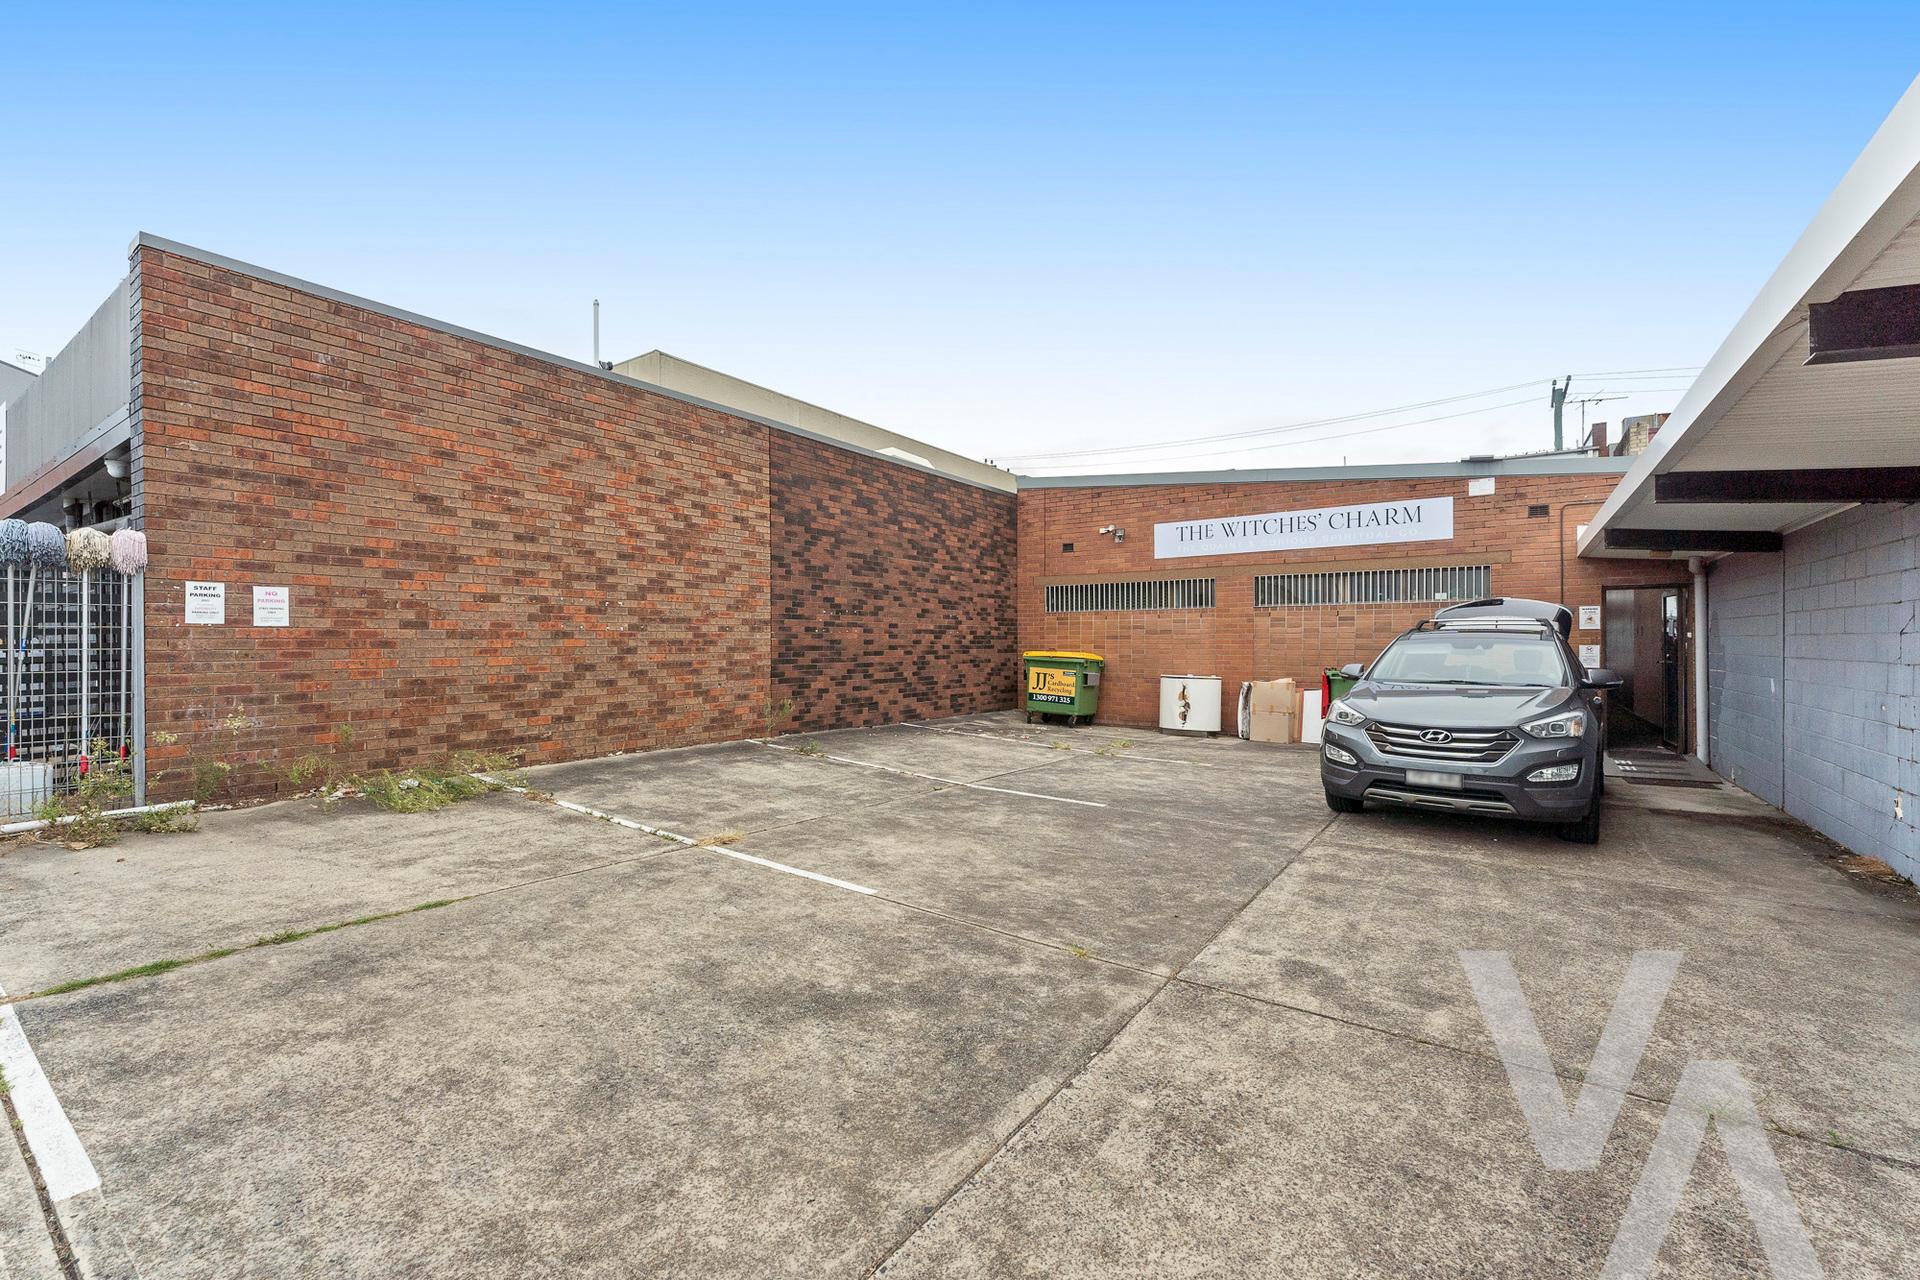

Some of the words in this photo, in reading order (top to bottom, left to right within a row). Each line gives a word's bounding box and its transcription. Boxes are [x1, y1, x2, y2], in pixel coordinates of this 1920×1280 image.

[1176, 524, 1214, 542] THE
[1328, 504, 1424, 530] CHARM
[1047, 686, 1072, 695] Recycling
[1047, 694, 1058, 702] 971
